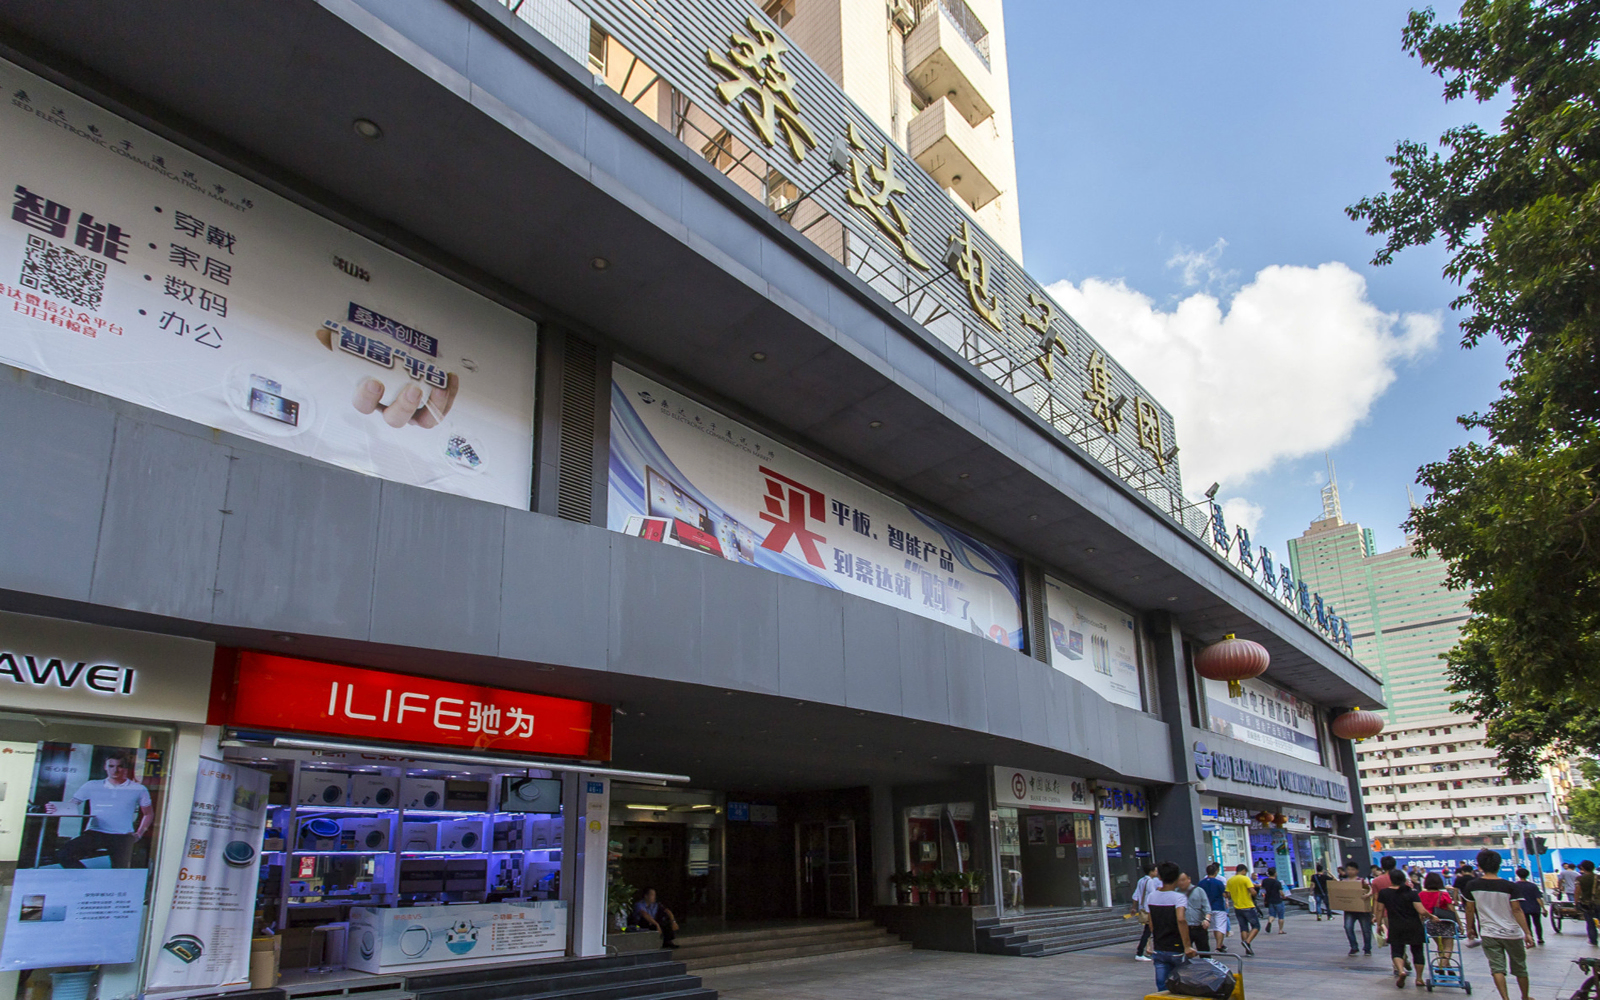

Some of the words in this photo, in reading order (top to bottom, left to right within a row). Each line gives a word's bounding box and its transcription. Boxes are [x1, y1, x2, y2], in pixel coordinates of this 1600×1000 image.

[11, 98, 34, 113] SED
[35, 109, 107, 149] ELECTRONIC
[109, 144, 206, 194] COMMUNICATION
[207, 191, 247, 212] MARKET
[11, 184, 131, 264] 智能
[174, 209, 237, 255] 穿戴
[707, 16, 1167, 473] 桑达电子集团
[168, 242, 233, 286] 家居
[164, 274, 228, 318] 数码
[158, 310, 223, 349] 办公
[353, 306, 432, 354] 桑达创造
[759, 465, 827, 570] 买
[831, 498, 954, 573] 平板、智能产品
[1029, 776, 1060, 795] 中国银行
